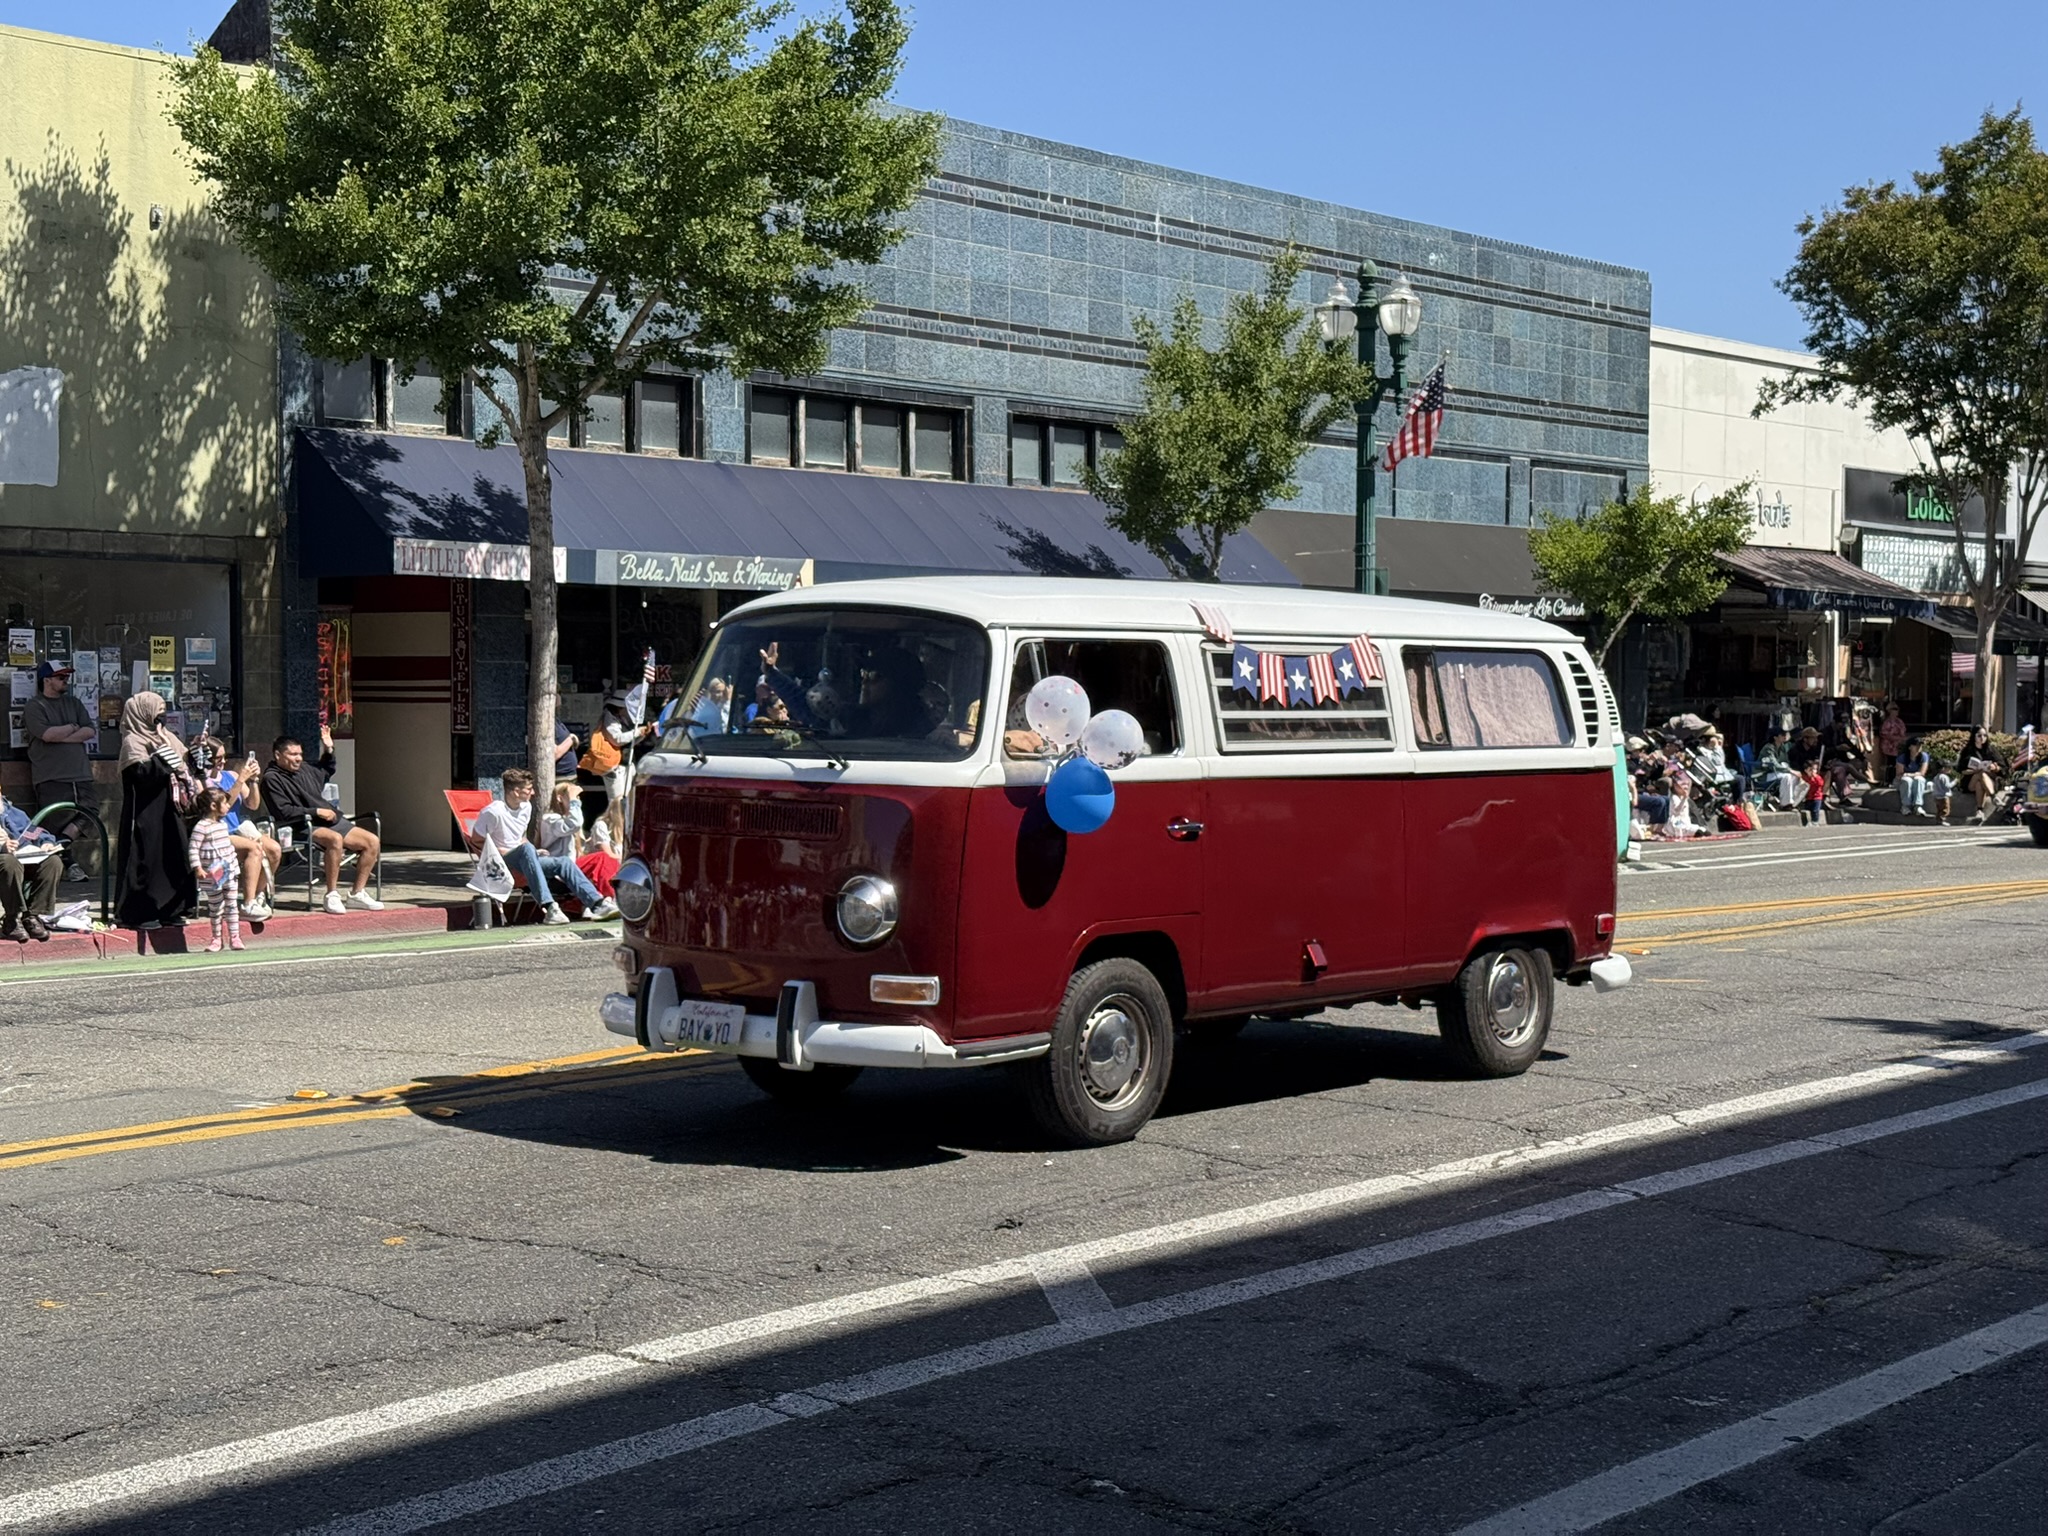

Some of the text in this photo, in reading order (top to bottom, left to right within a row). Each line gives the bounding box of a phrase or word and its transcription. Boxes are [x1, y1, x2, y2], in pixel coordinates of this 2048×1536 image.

[620, 554, 793, 590] Bella Nail Spa & Waxing
[455, 577, 467, 639] RTUNE
[1479, 593, 1585, 619] Triumphant Life Church
[455, 661, 467, 723] TELLER
